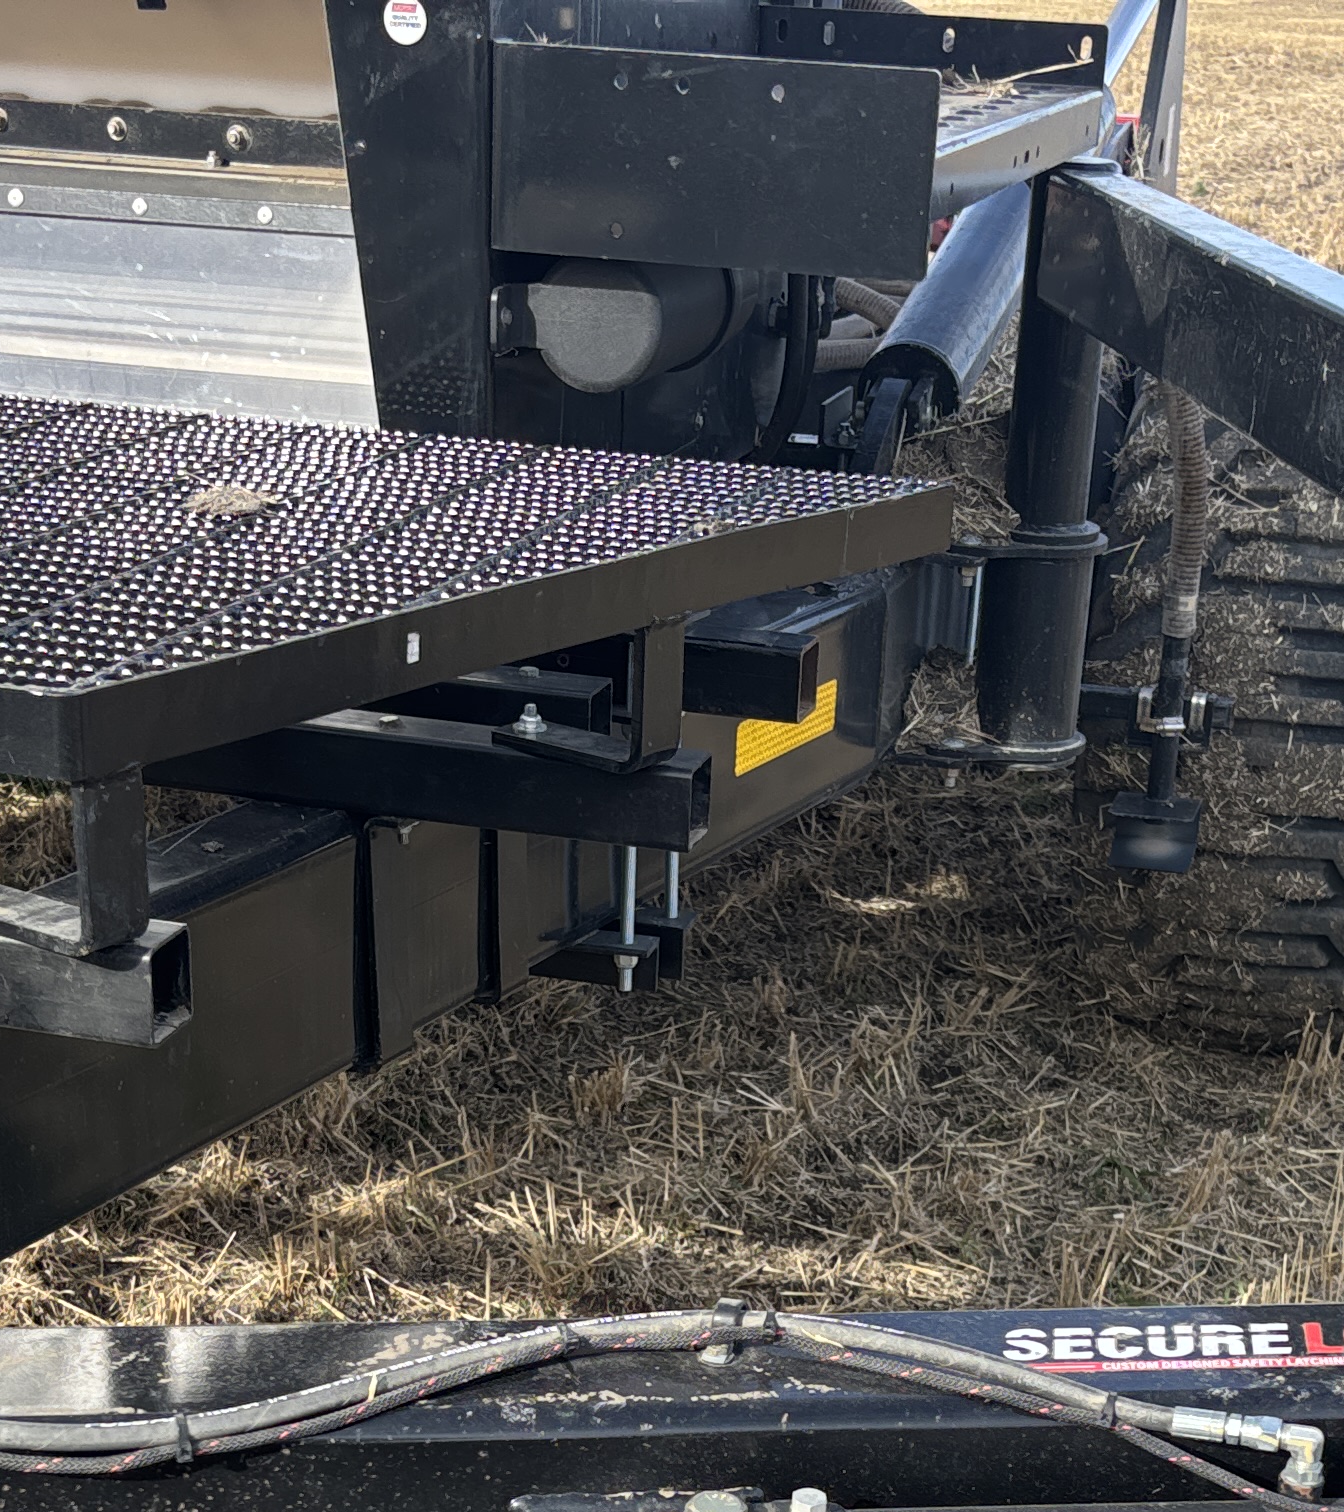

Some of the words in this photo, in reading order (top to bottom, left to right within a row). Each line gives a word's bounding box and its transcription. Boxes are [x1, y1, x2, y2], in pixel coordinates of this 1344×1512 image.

[1102, 1361, 1159, 1371] CUSTOM
[1161, 1359, 1231, 1370] DESIGNED
[1233, 1358, 1284, 1368] SAFETY
